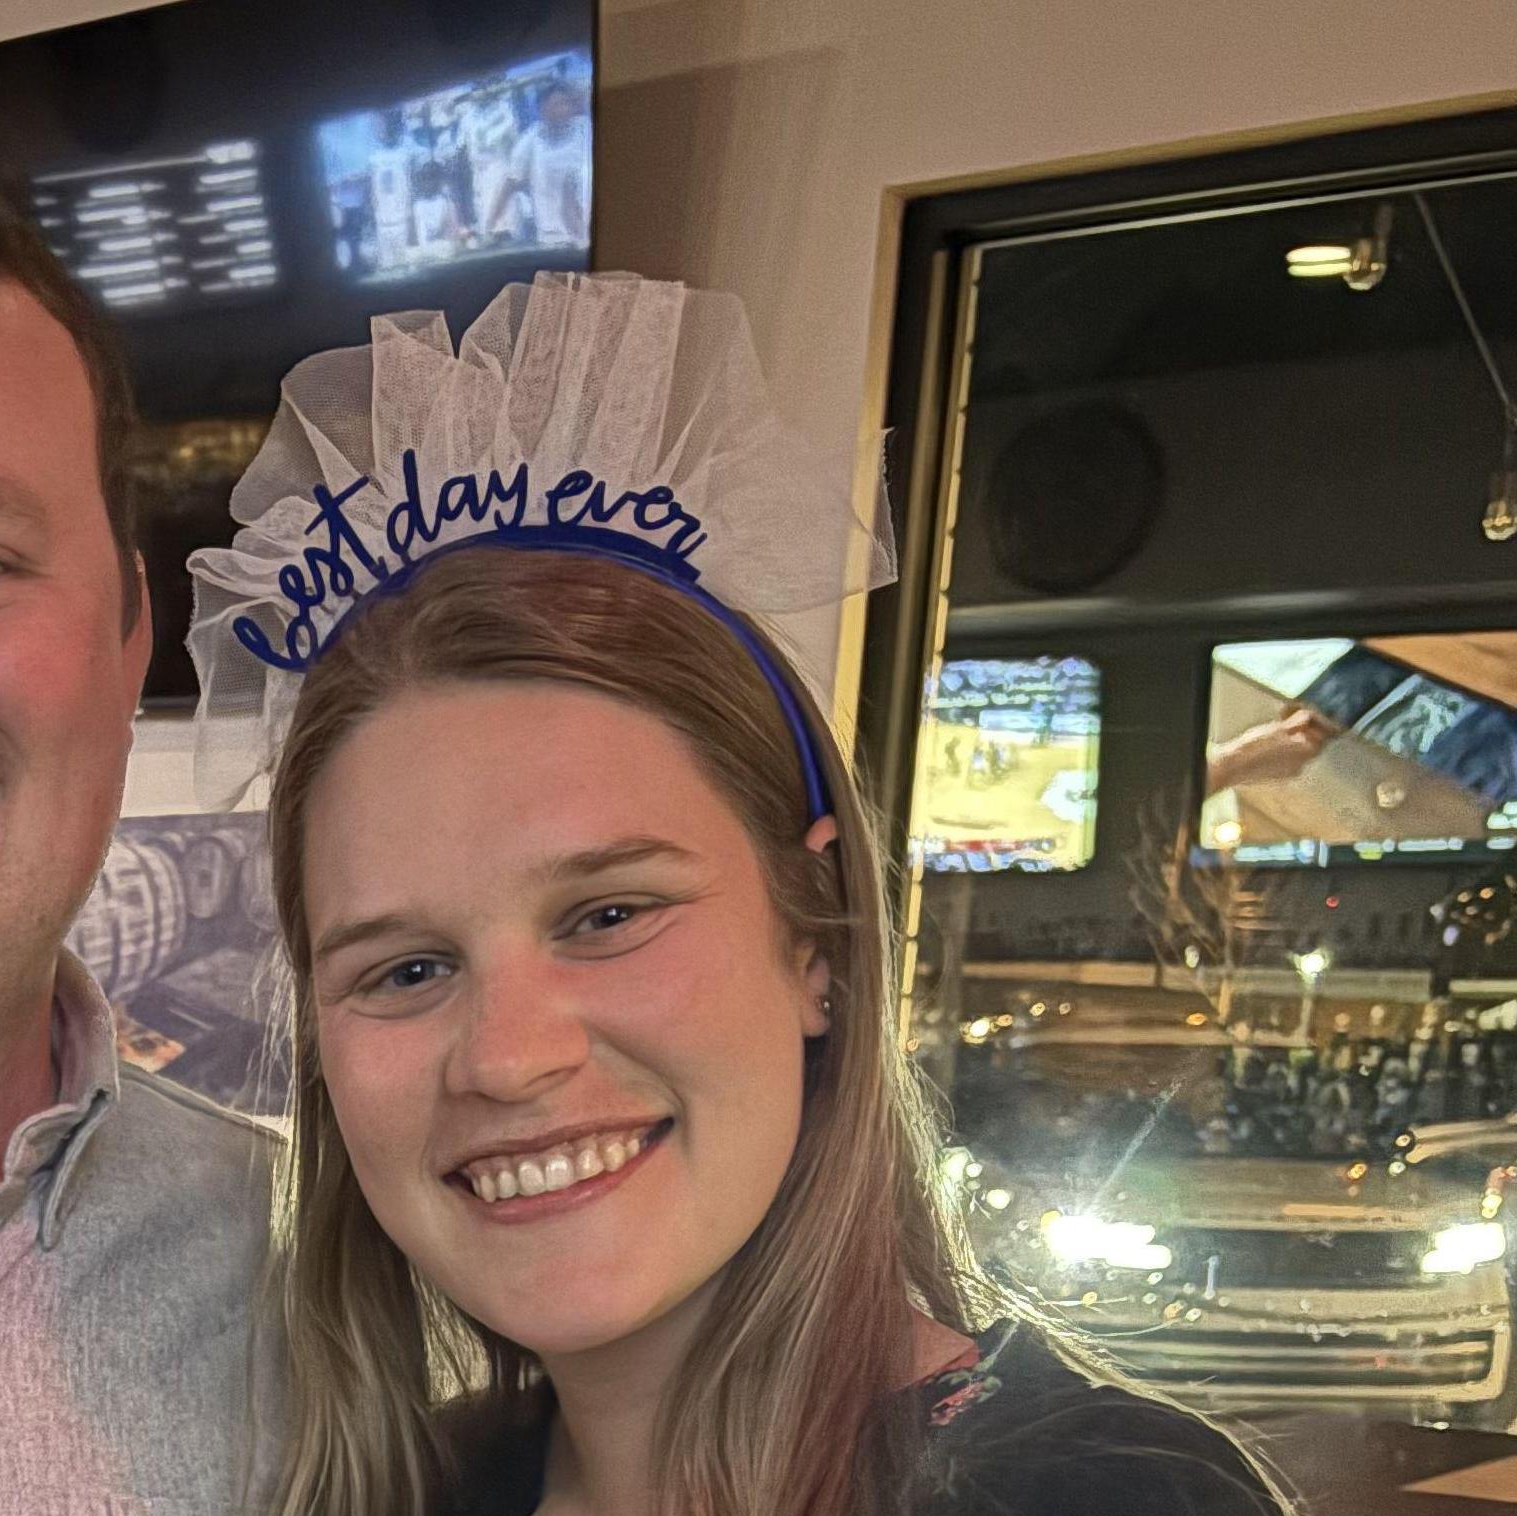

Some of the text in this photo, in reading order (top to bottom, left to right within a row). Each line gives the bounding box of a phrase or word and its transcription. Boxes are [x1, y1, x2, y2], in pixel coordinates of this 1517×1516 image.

[232, 448, 708, 673] best day ever
